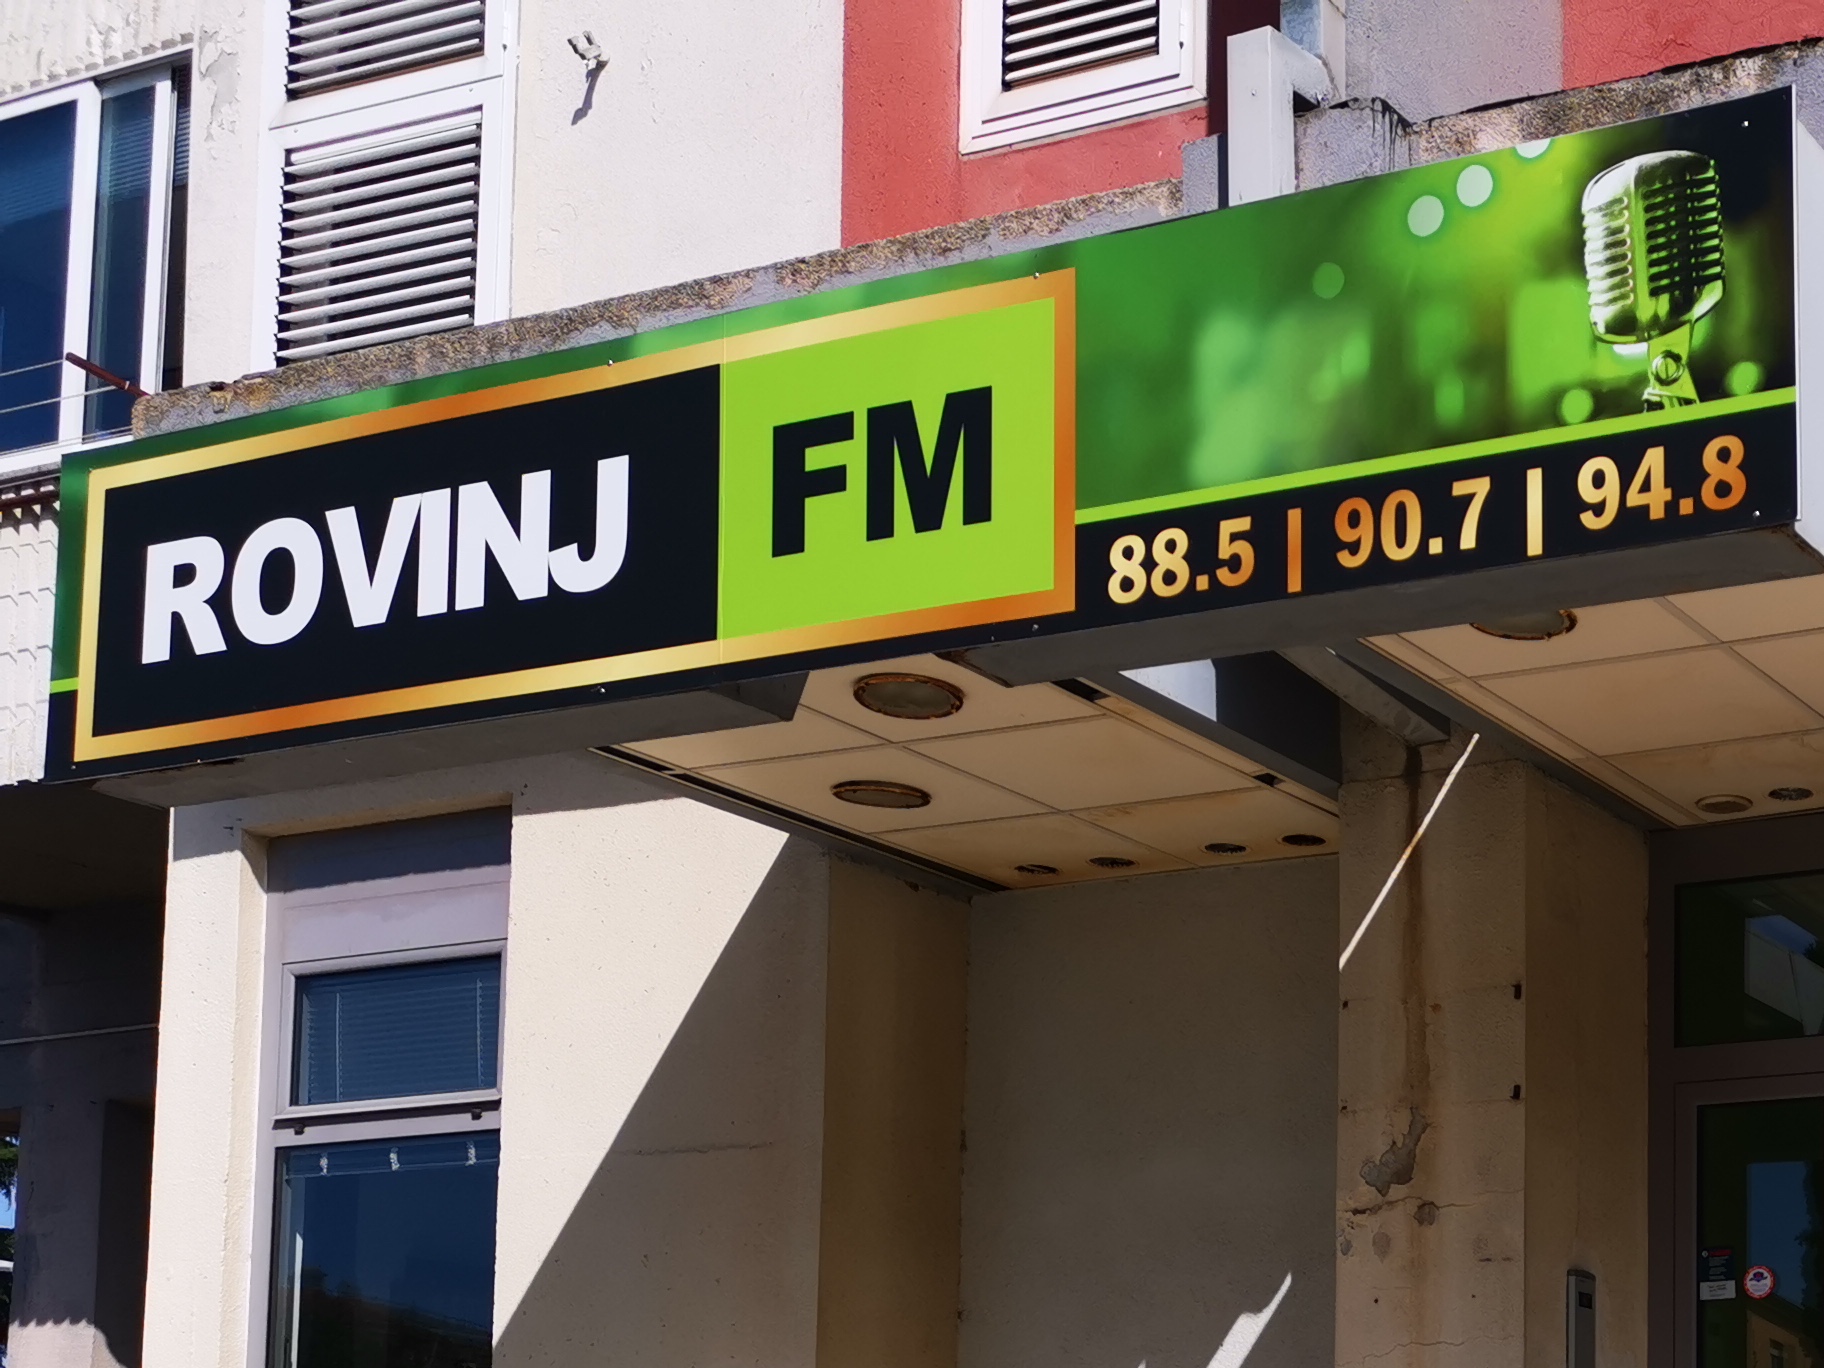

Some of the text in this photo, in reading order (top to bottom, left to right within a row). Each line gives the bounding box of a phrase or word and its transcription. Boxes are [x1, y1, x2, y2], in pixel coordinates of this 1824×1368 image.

[141, 386, 994, 665] ROVINJ FM
[1106, 515, 1256, 605] 88.5
[1333, 475, 1492, 568] 90.7
[1576, 434, 1749, 530] 94.8
